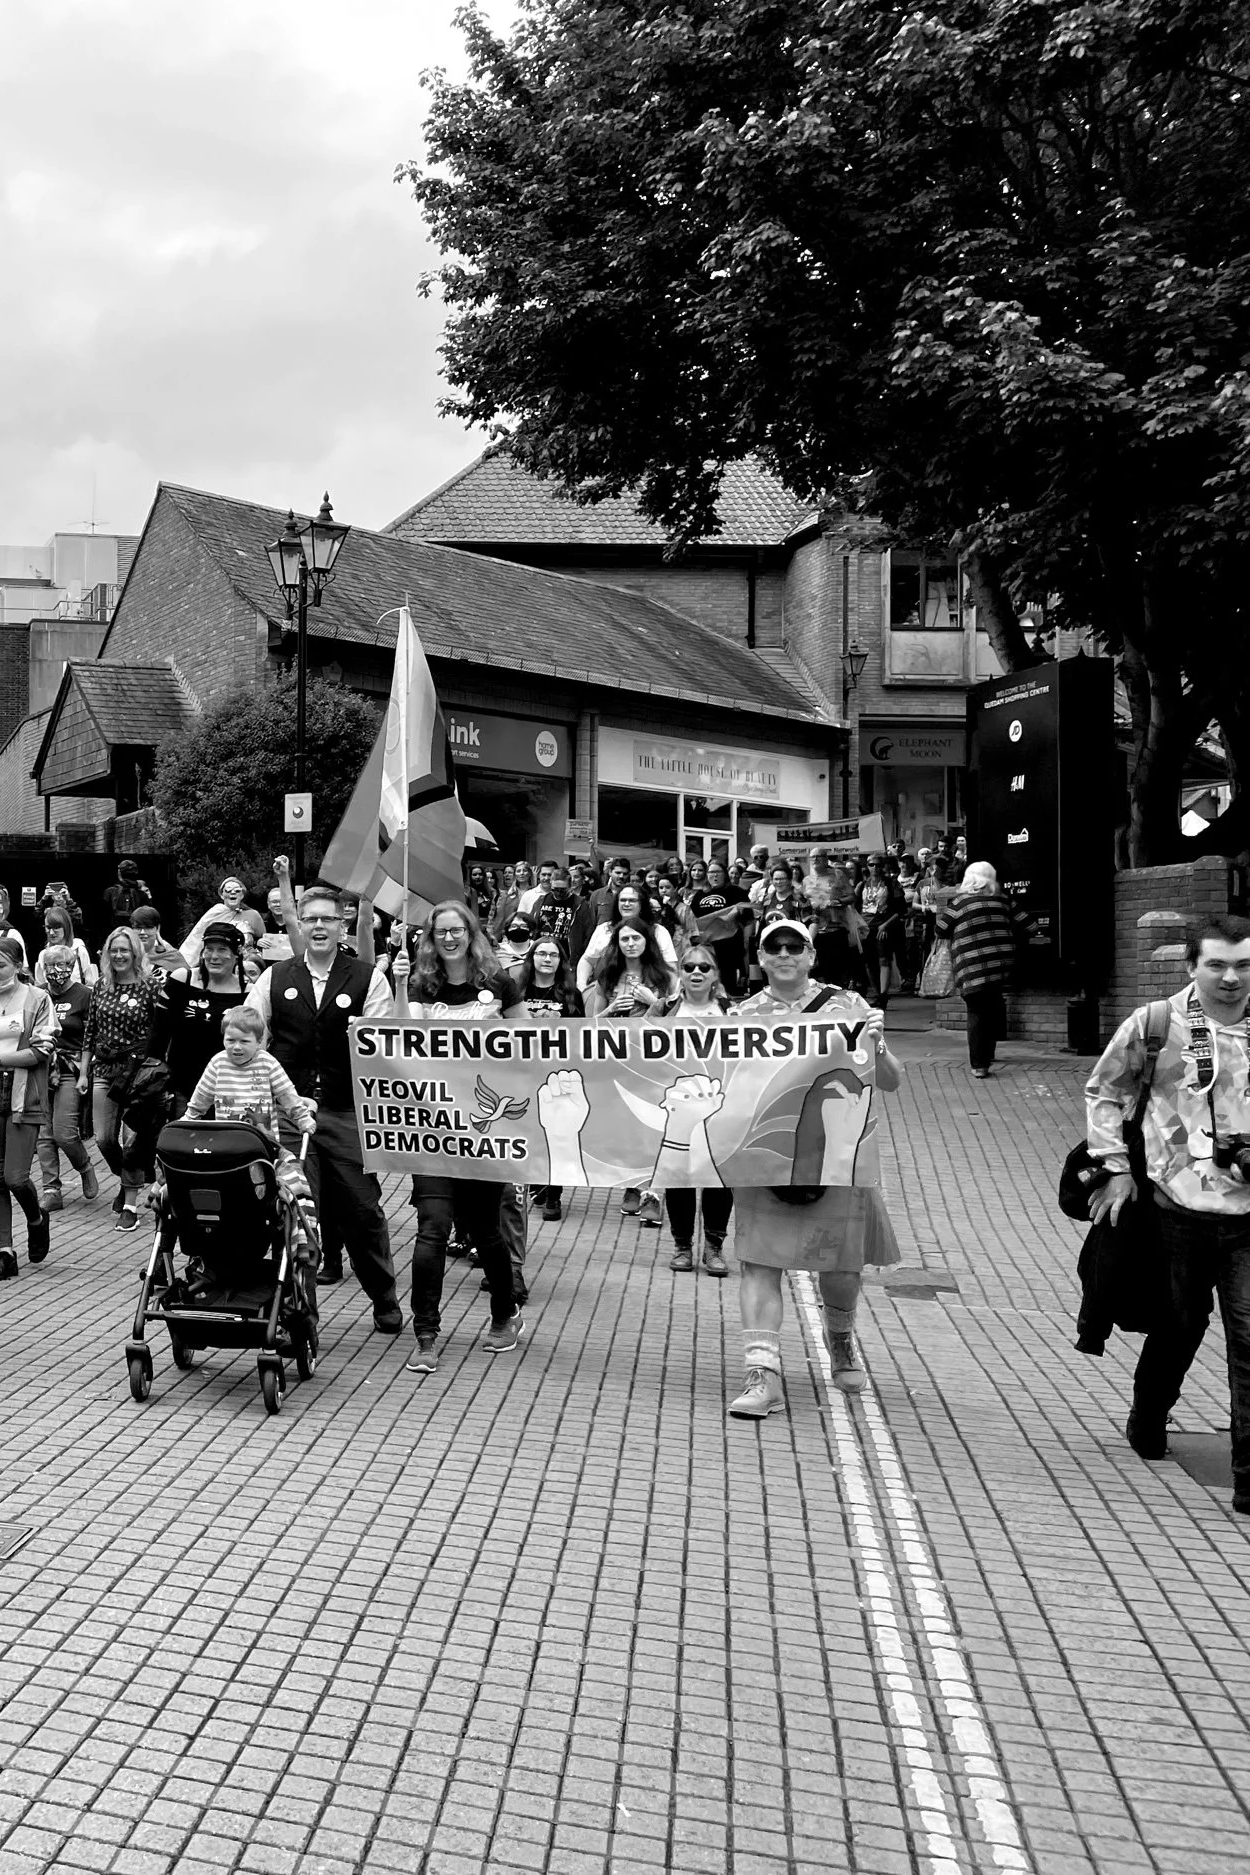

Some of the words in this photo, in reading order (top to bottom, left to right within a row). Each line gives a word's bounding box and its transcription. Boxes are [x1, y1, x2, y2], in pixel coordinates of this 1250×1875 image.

[1004, 692, 1029, 703] SHOPPING
[1030, 686, 1049, 696] CENTRE
[899, 738, 954, 747] ELEPHANT
[910, 749, 942, 758] MOON
[638, 755, 656, 769] THE
[661, 758, 692, 774] LITTLE
[698, 763, 724, 779] HOUSE
[745, 770, 776, 785] BEAUTY
[356, 1027, 568, 1059] STRENGTH
[583, 1029, 628, 1059] IN
[643, 1021, 867, 1059] DIVERSITY
[360, 1078, 454, 1103] YEOVIL
[363, 1104, 468, 1131] LIBERAL
[365, 1130, 527, 1159] DEMOCRATS
